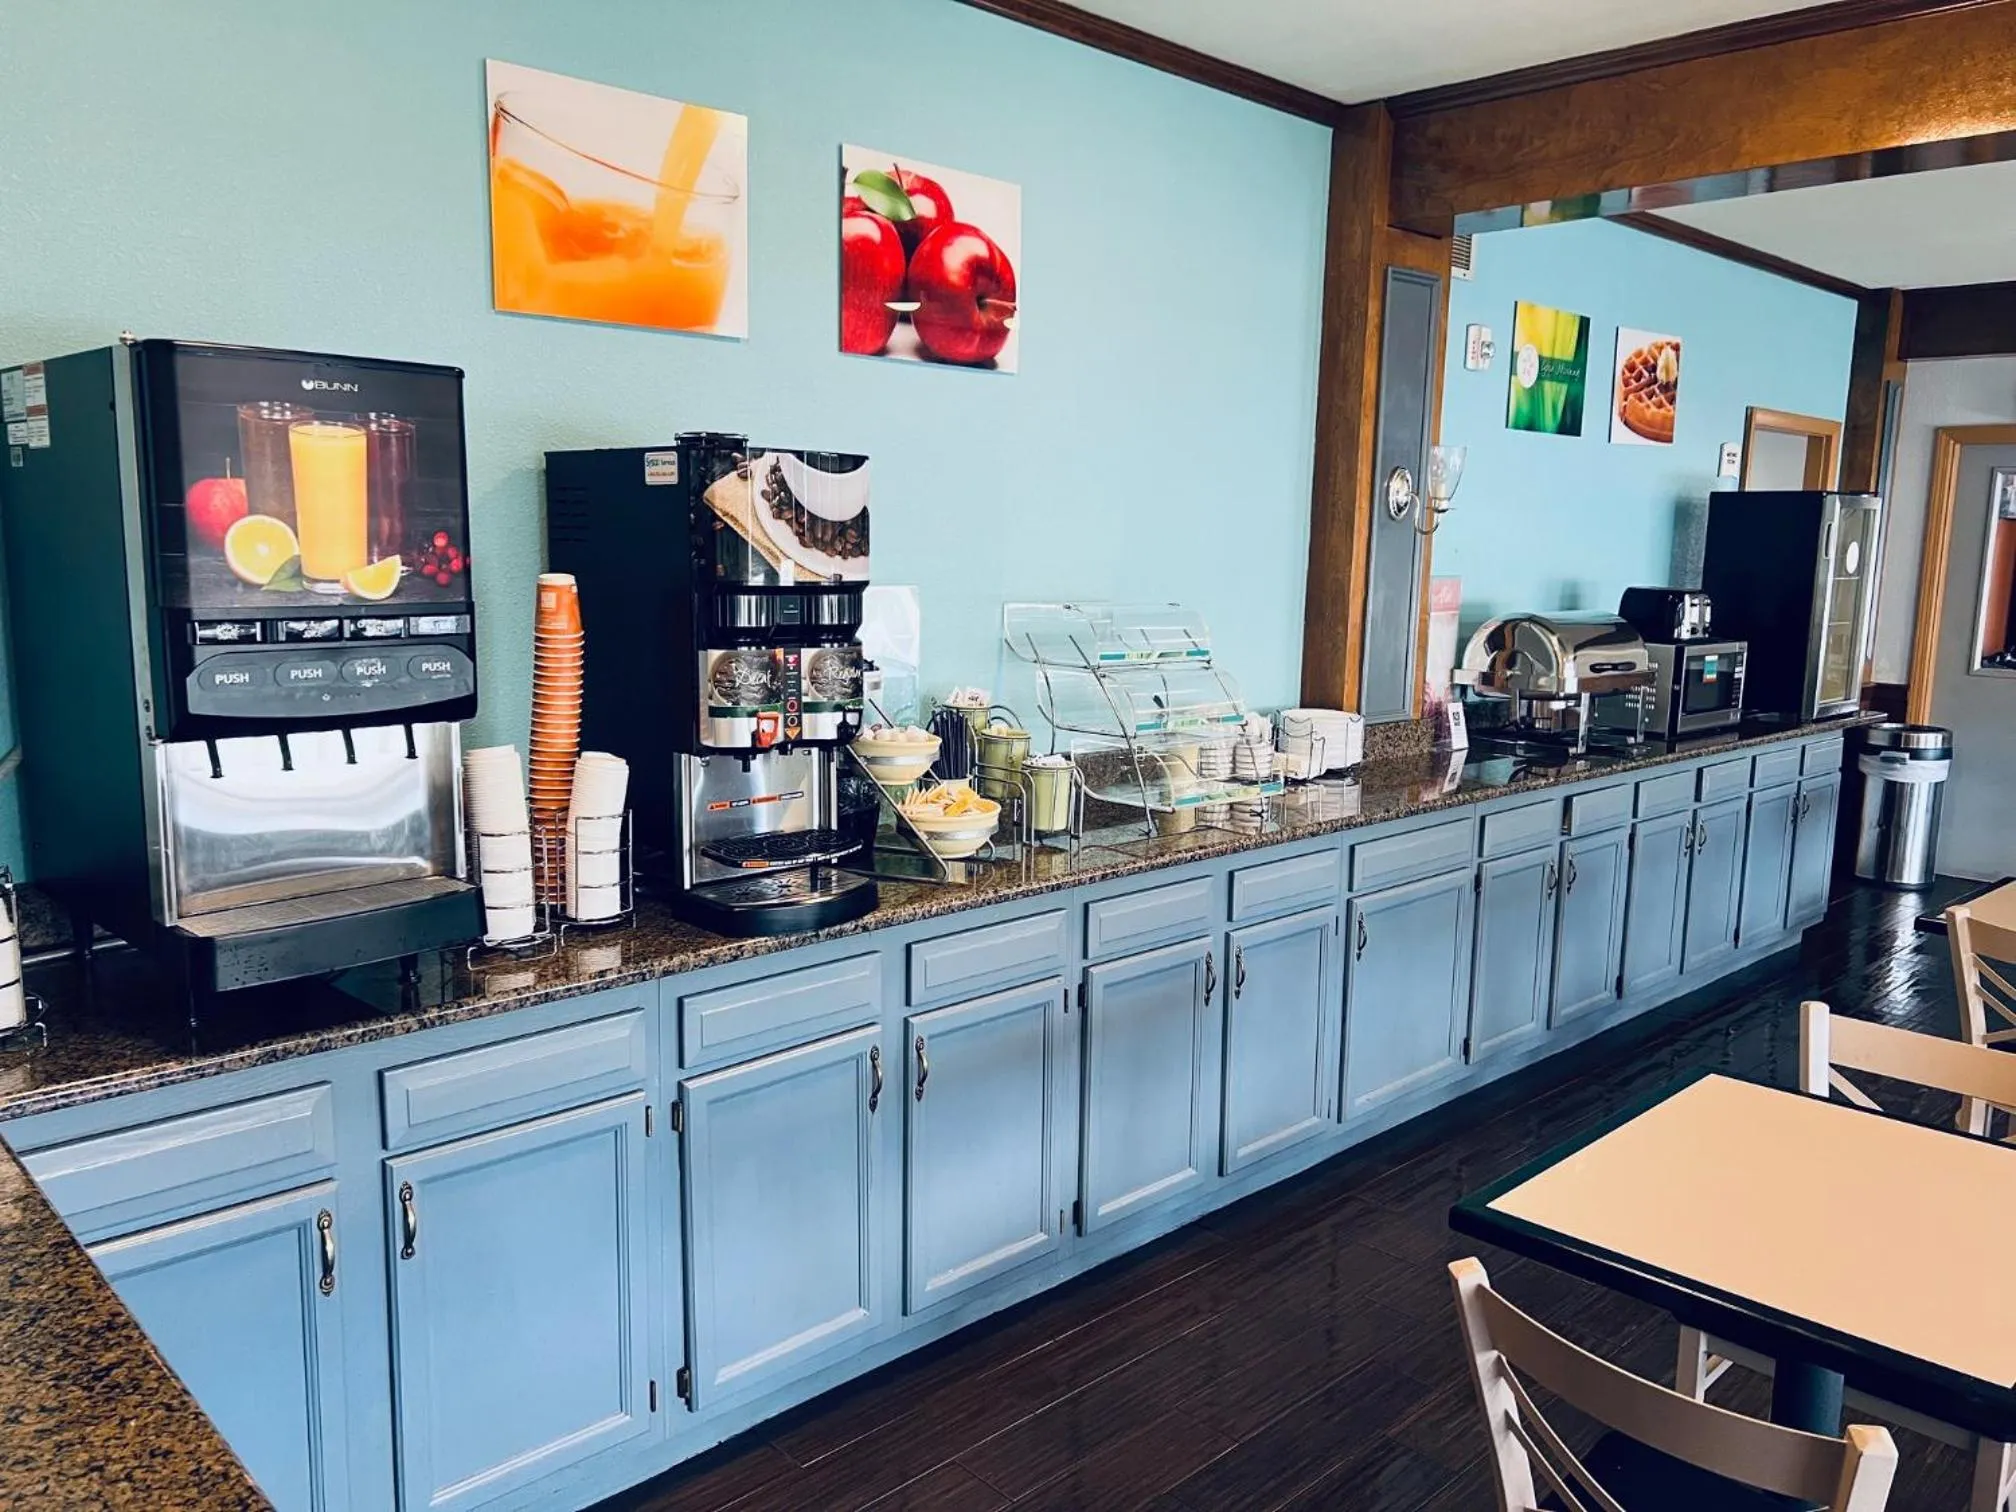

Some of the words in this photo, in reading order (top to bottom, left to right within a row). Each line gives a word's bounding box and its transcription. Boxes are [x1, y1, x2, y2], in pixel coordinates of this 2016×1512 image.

[314, 380, 359, 391] BUNN
[356, 665, 387, 676] PUSH
[421, 661, 451, 672] PUSH
[214, 673, 250, 685] PUSH
[289, 668, 323, 680] PUSH
